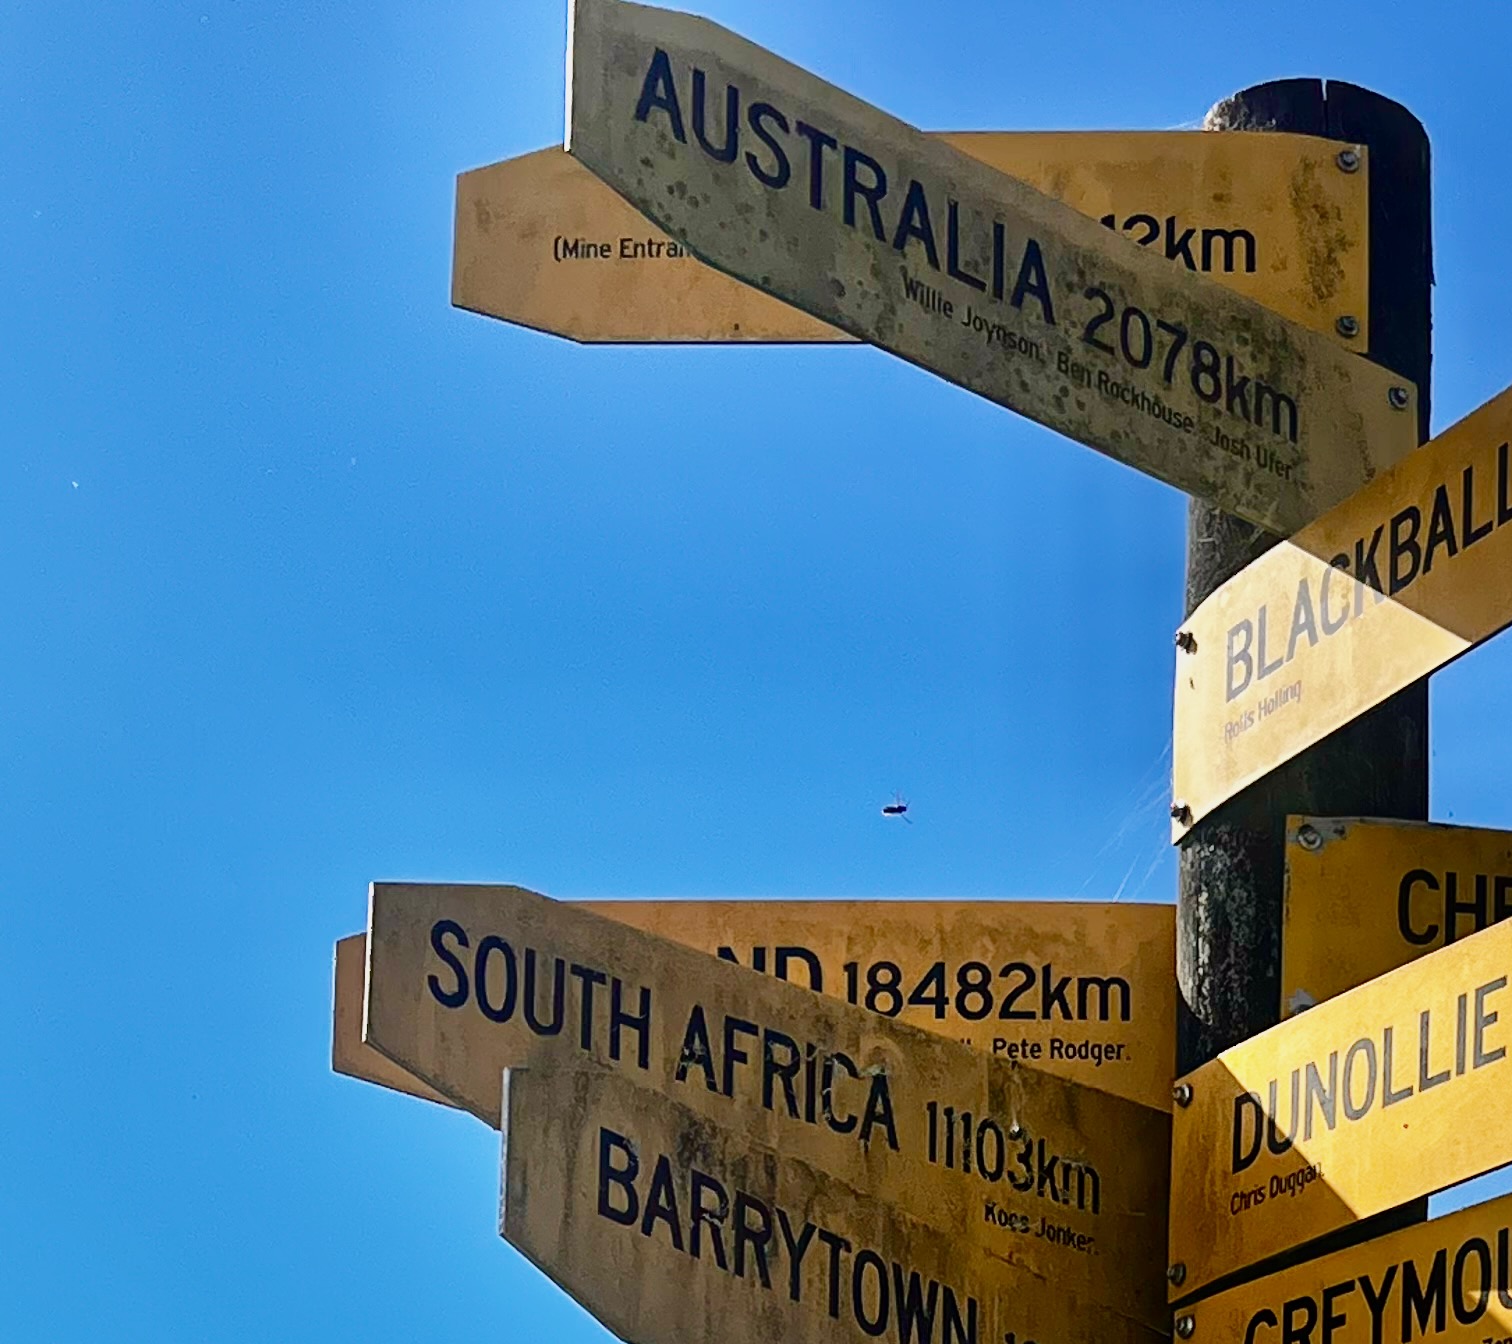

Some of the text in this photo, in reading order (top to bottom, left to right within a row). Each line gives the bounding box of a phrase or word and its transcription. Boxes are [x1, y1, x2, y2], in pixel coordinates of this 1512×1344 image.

[554, 236, 612, 262] (Mine
[635, 49, 1298, 444] AUSTRALIA 2078km
[900, 265, 954, 319] Willie
[1056, 351, 1092, 389] Ben
[1208, 427, 1251, 461] Josh
[843, 960, 1132, 1022] 18482km
[993, 1038, 1132, 1068] Pete Rodger.
[427, 919, 1101, 1216] SOUTH AFRICA 11103km
[1231, 975, 1509, 1176] DUNOLLIE
[1230, 1184, 1267, 1216] Chris
